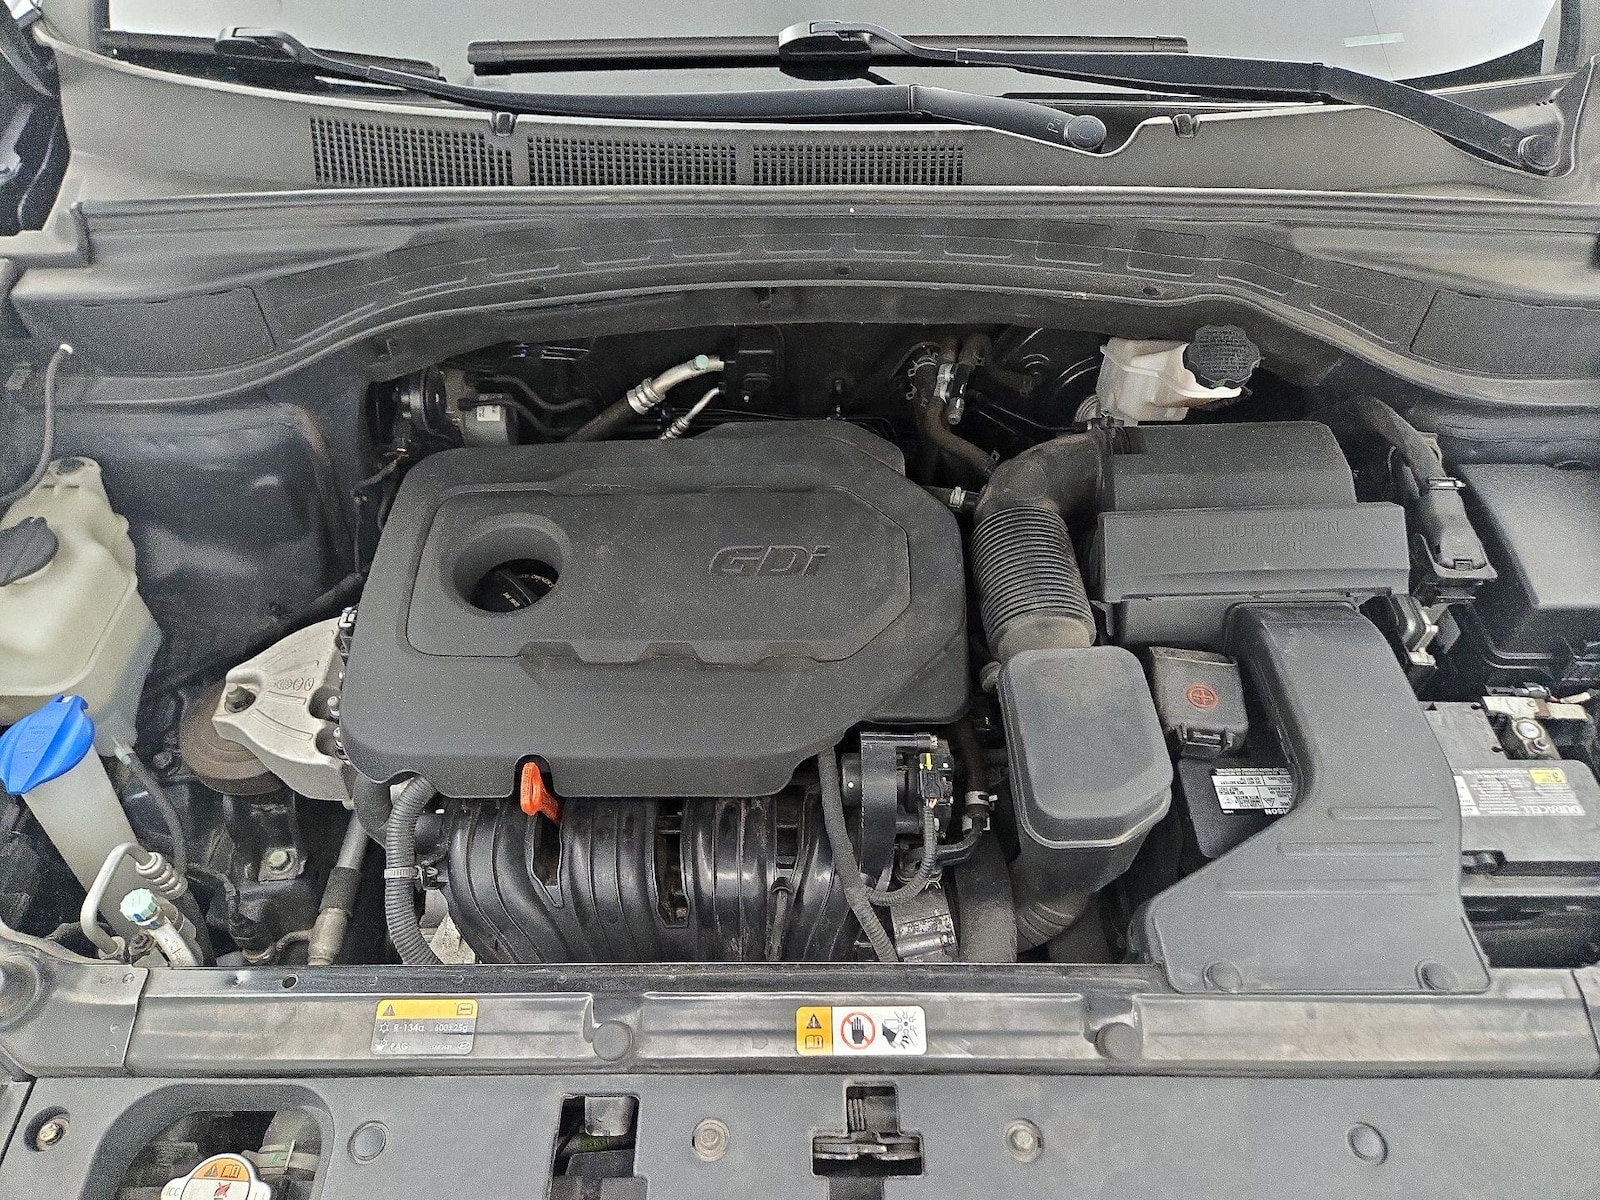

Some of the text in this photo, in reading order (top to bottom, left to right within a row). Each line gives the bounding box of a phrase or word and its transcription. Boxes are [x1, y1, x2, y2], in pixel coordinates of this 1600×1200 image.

[1222, 523, 1257, 538] OUT
[1262, 521, 1287, 537] TO
[1291, 519, 1341, 536] OPEN
[708, 544, 831, 577] GDi
[1522, 804, 1582, 814] DURACELL
[393, 1023, 425, 1032] R-134a
[390, 1042, 409, 1050] PAG
